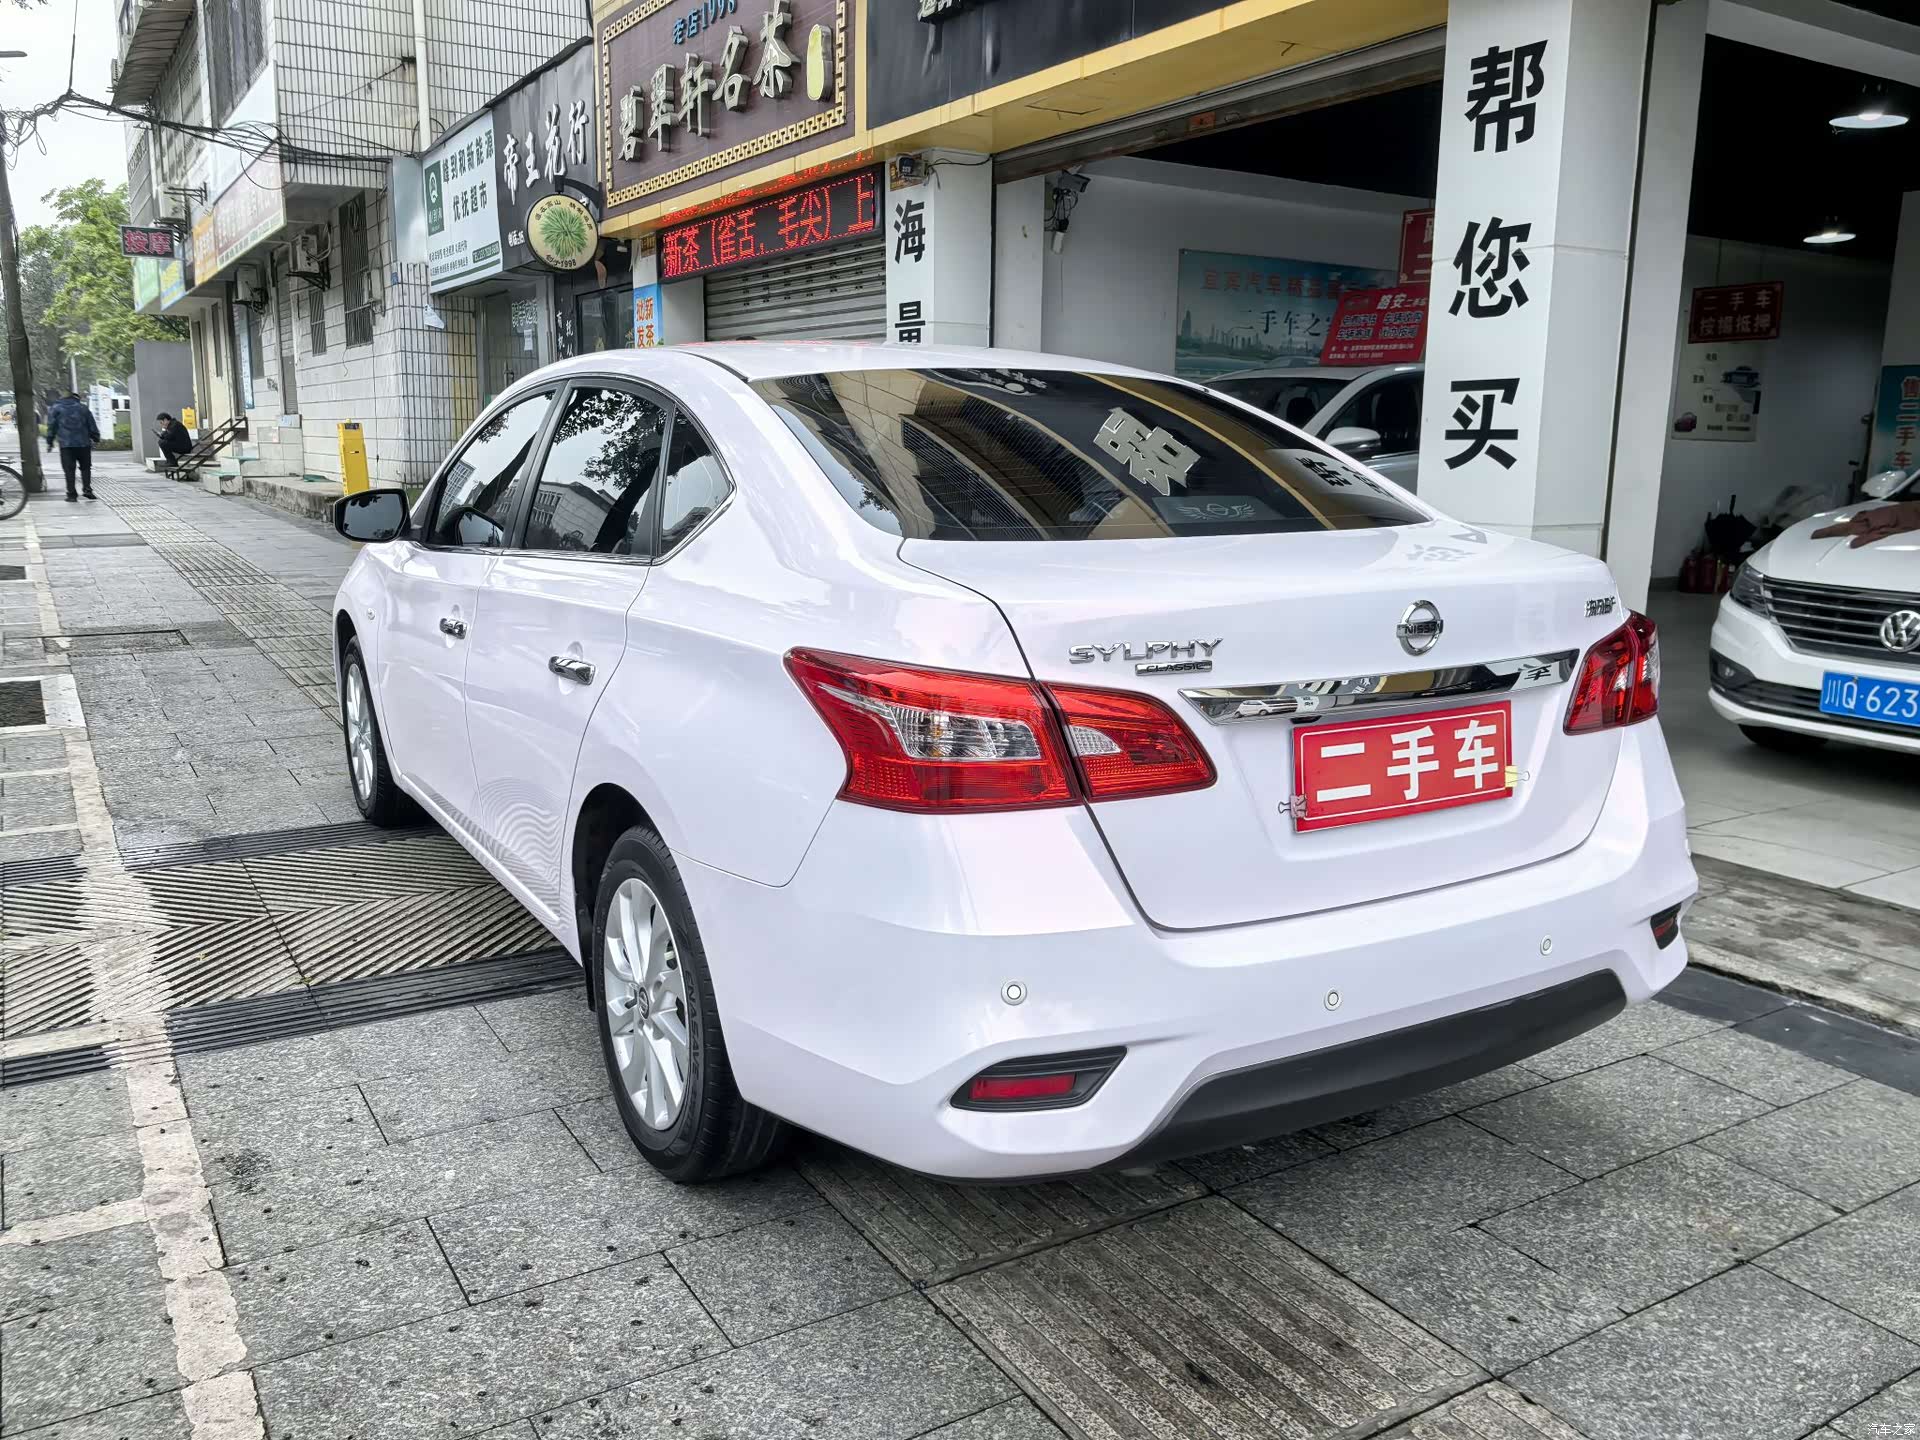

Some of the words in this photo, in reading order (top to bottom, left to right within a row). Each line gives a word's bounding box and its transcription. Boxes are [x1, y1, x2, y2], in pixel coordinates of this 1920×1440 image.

[124, 230, 172, 255] 按摩
[1445, 39, 1548, 470] 帮您买
[1069, 638, 1224, 664] SYLPHY
[1146, 663, 1206, 673] CLASSIC
[1316, 719, 1499, 801] 二手车
